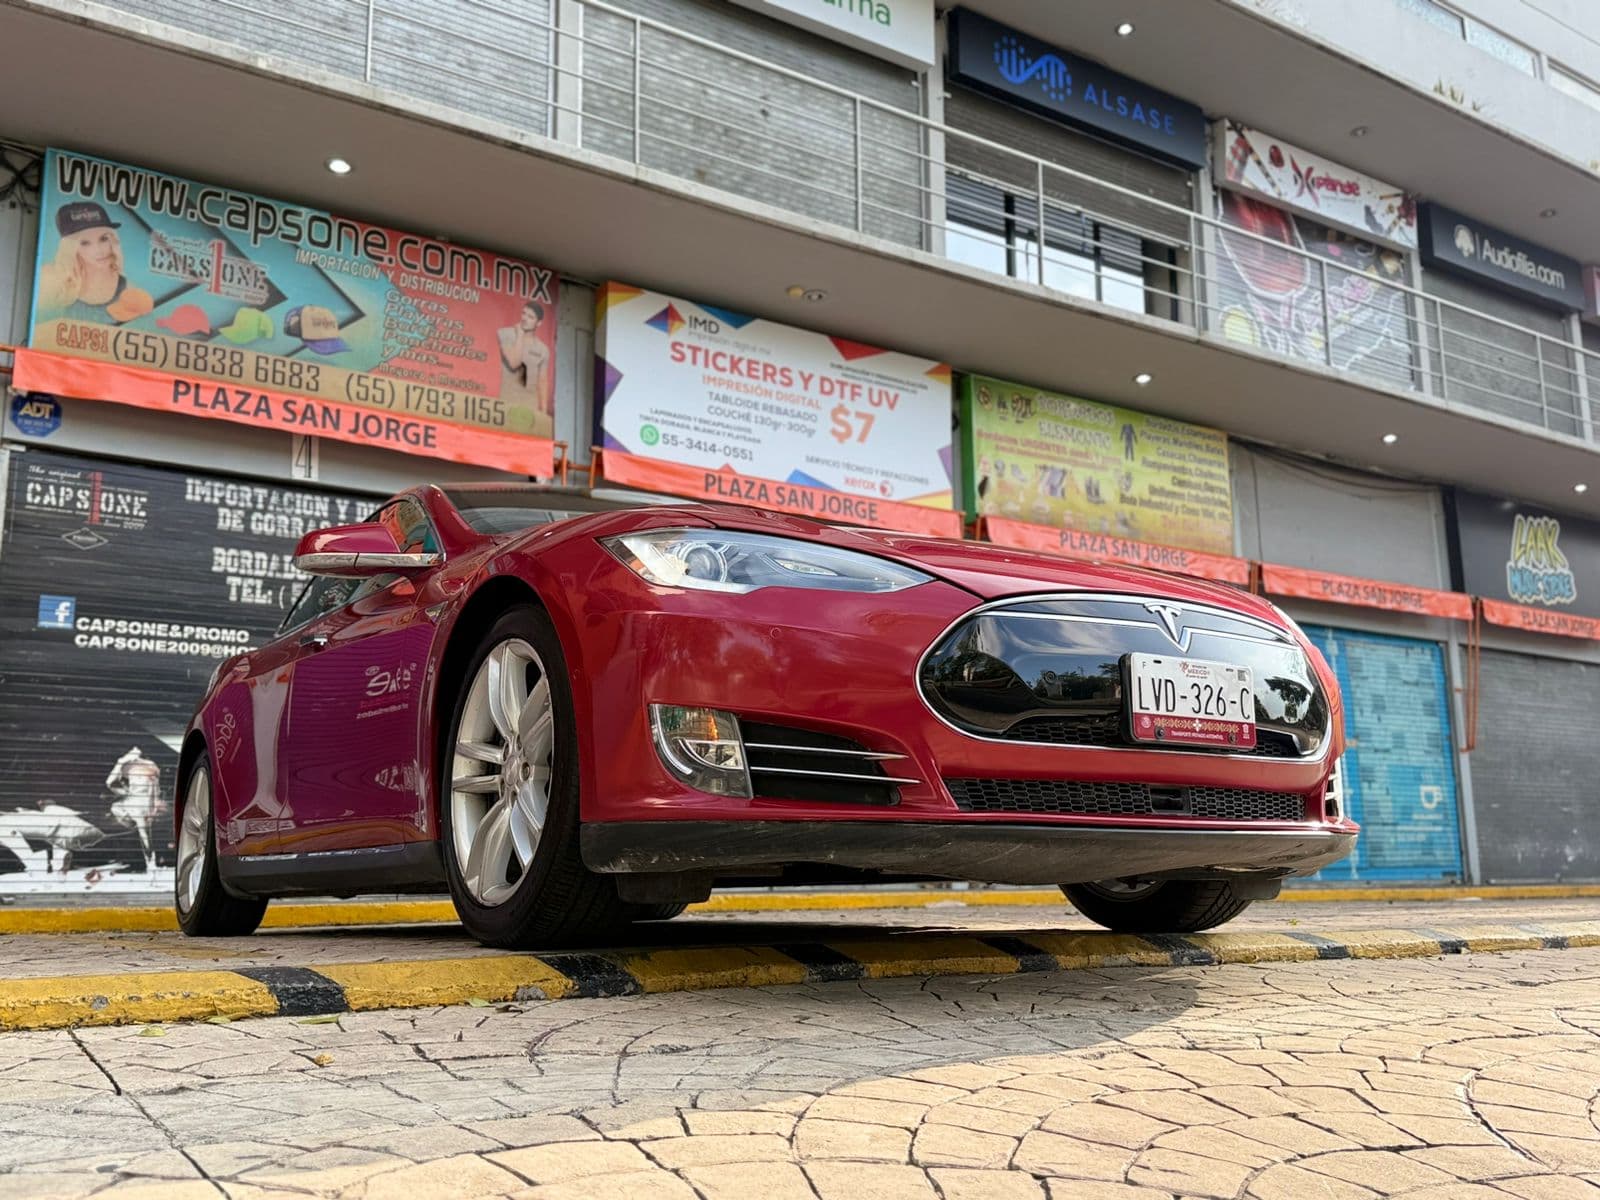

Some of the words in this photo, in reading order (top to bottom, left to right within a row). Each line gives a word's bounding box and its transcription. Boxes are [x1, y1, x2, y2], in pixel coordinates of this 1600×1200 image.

[1083, 82, 1177, 137] ALSASE
[56, 154, 553, 306] www.capsone.com.mx
[295, 251, 381, 281] IMPORTACION
[387, 270, 396, 283] Y
[400, 274, 481, 305] DISTRIBUCION
[384, 302, 465, 332] Playeras
[385, 288, 449, 315] Gorras
[688, 315, 720, 335] IMD
[113, 329, 169, 369] (55)
[174, 340, 244, 380] 6838
[254, 354, 321, 393] 6683
[345, 372, 396, 409] (55)
[404, 383, 456, 420] 1793
[463, 395, 506, 427] 1155
[669, 340, 795, 389] STICKERS
[797, 369, 815, 392] Y
[819, 375, 863, 402] DTF
[867, 386, 900, 412] UV
[701, 373, 773, 400] IMPRESIÓN
[774, 390, 823, 411] DIGITAL
[18, 401, 55, 420] ADT
[172, 378, 272, 421] PLAZA
[281, 399, 341, 432] SAN
[347, 411, 437, 449] JORGE
[707, 390, 760, 413] TABLOIDE
[828, 401, 876, 445] $7
[294, 434, 313, 480] 4
[661, 432, 754, 462] 55-3414-0551
[184, 477, 330, 518] IMPORTACION
[335, 498, 350, 521] Y
[703, 472, 771, 504] PLAZA
[775, 485, 816, 512] SAN
[819, 493, 879, 522] JORGE
[844, 476, 877, 491] xerox
[216, 506, 245, 532] DE
[1059, 531, 1109, 555] PLAZA
[1111, 540, 1141, 561] SAN
[1145, 547, 1189, 568] JORGE
[226, 575, 273, 605] TEL:
[1321, 579, 1361, 600] PLAZA
[1363, 585, 1387, 606] SAN
[1391, 588, 1425, 610] JORGE
[74, 634, 259, 659] CAPSONE2009@HO
[75, 616, 250, 644] CAPSONE&PROMO
[1137, 675, 1251, 721] LVD-326-C
